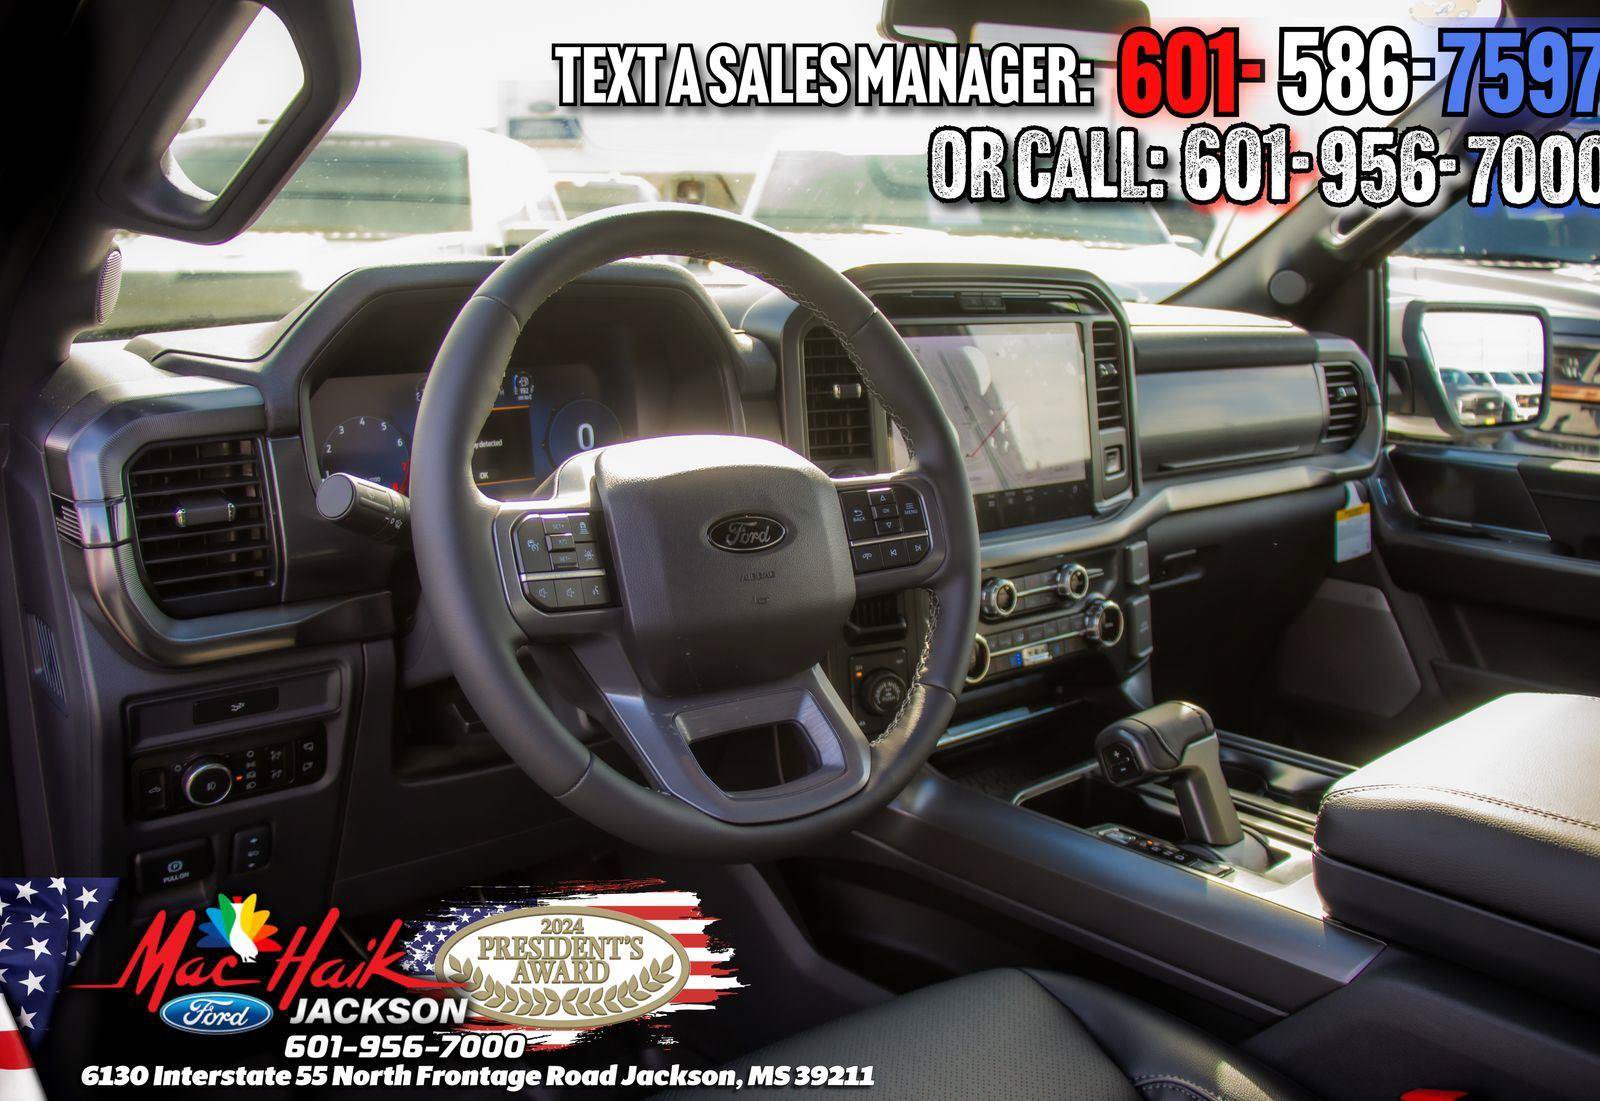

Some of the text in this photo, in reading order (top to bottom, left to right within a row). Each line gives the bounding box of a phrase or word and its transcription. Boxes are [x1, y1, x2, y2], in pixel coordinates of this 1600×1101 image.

[338, 426, 345, 435] 3
[381, 422, 387, 431] 5
[577, 423, 595, 451] 0
[397, 438, 403, 447] 6
[325, 445, 332, 454] 2
[726, 521, 772, 546] Ford
